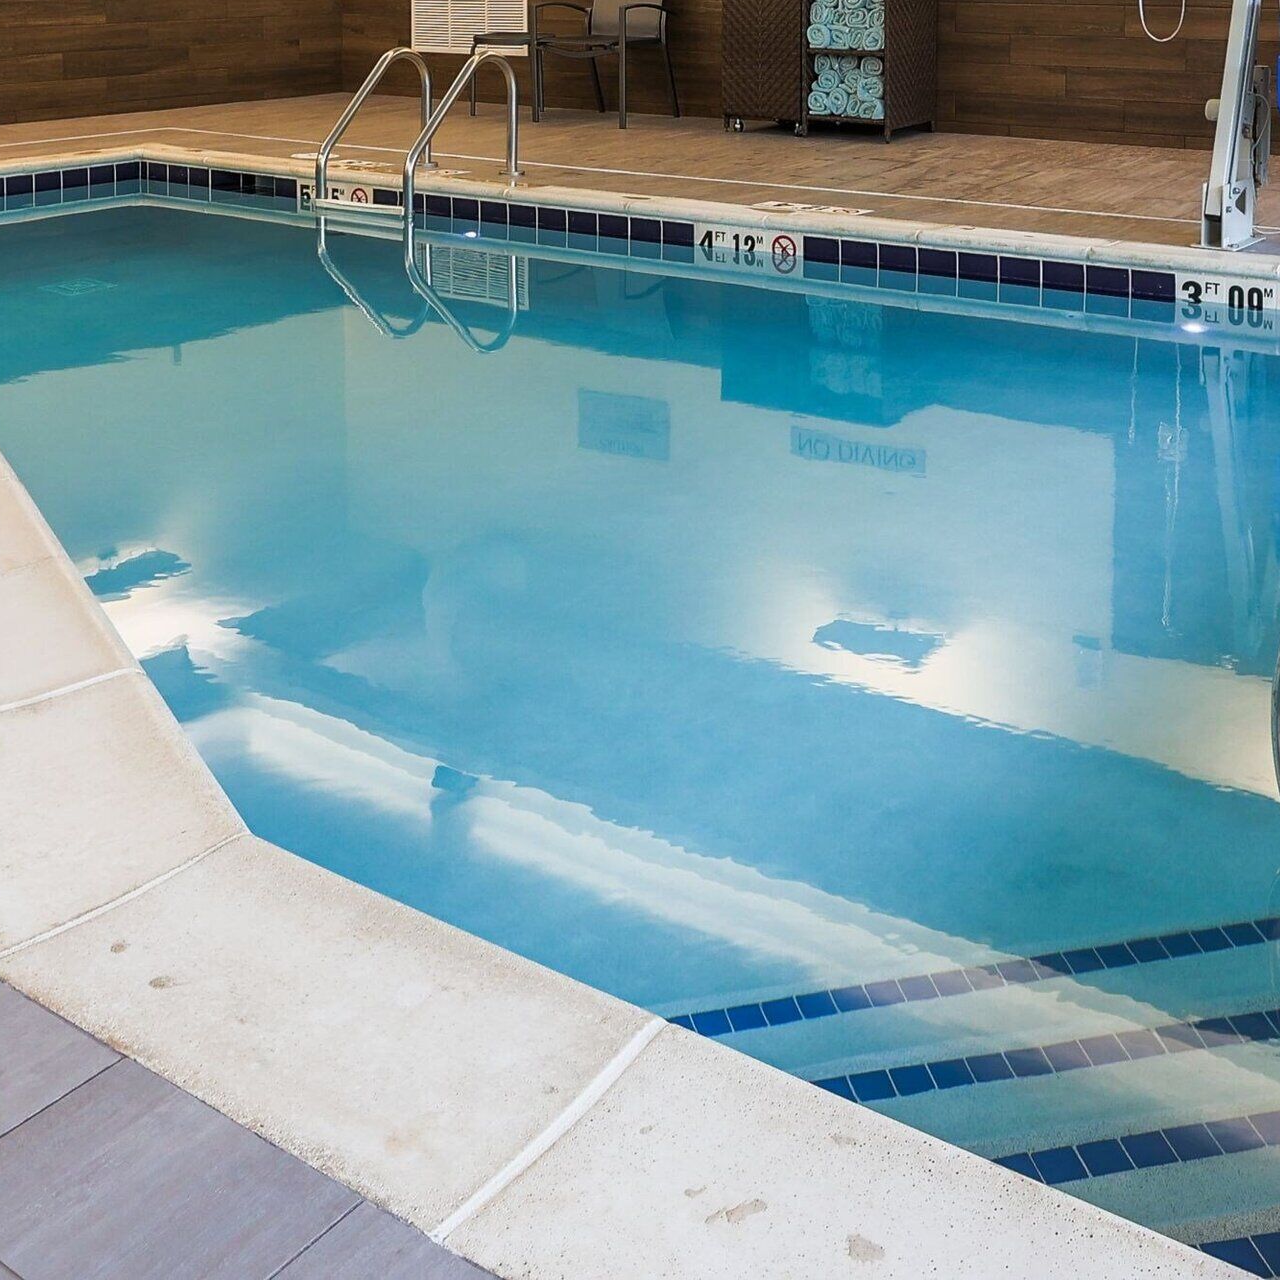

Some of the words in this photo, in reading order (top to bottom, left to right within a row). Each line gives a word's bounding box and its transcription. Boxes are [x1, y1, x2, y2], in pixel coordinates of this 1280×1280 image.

[715, 231, 726, 242] FT
[757, 236, 763, 245] M
[1181, 281, 1203, 309] 3
[1204, 282, 1220, 295] FT
[1263, 288, 1274, 299] M
